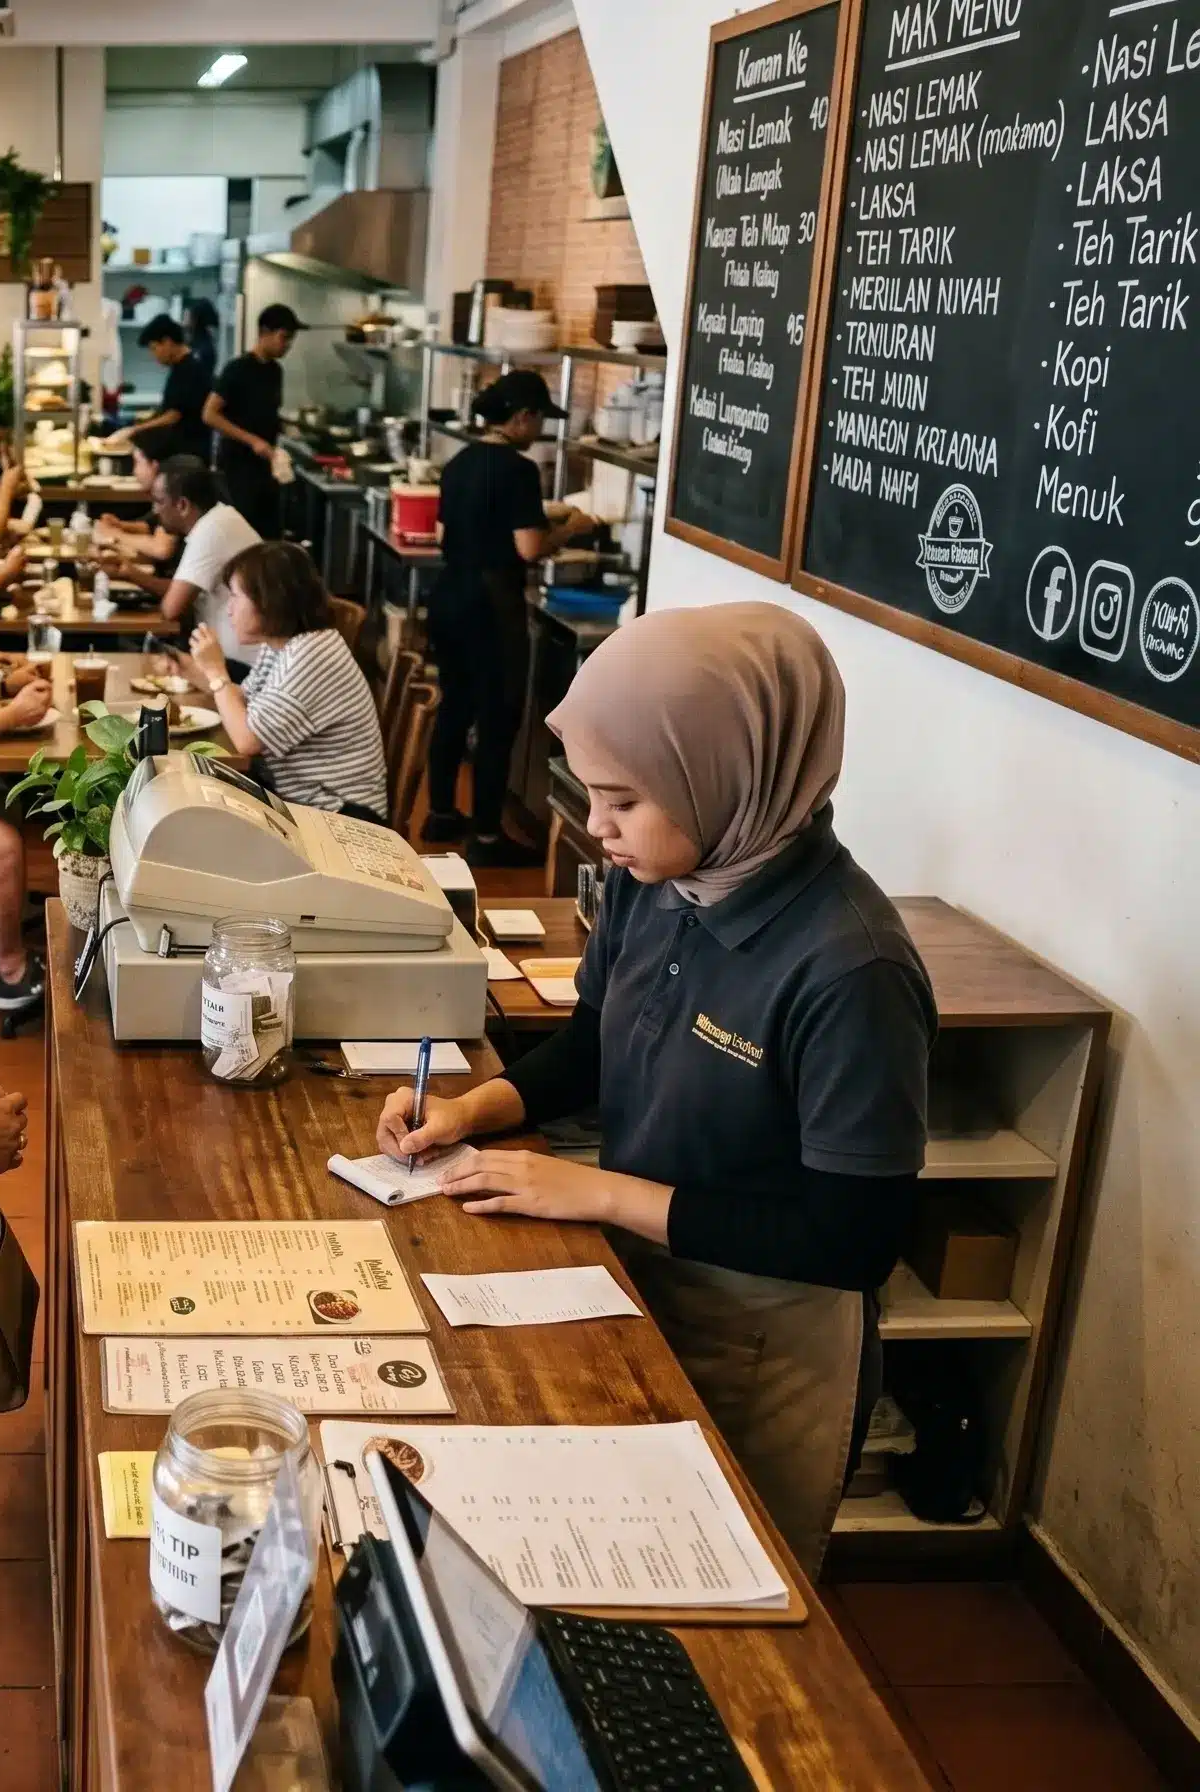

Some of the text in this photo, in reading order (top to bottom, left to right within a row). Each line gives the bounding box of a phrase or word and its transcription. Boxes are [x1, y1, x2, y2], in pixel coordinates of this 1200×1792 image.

[888, 0, 1022, 59] MAK MENU
[1092, 23, 1158, 89] Nasi
[809, 96, 829, 131] 40
[868, 70, 983, 129] NASI LEMAK
[863, 133, 905, 174] NASI
[910, 122, 975, 169] LEMAK
[859, 181, 916, 221] LAKSA
[740, 213, 759, 247] Teh
[797, 210, 816, 245] 30
[856, 226, 956, 266] TEH TARIK
[1072, 210, 1199, 266] Teh Tarik
[1062, 278, 1190, 331] Teh Tarik
[842, 365, 876, 403] TEH
[1052, 340, 1112, 403] Kopi
[1044, 403, 1099, 457] Kofi
[1035, 464, 1125, 527] Menuk
[169, 1534, 200, 1561] TIP
